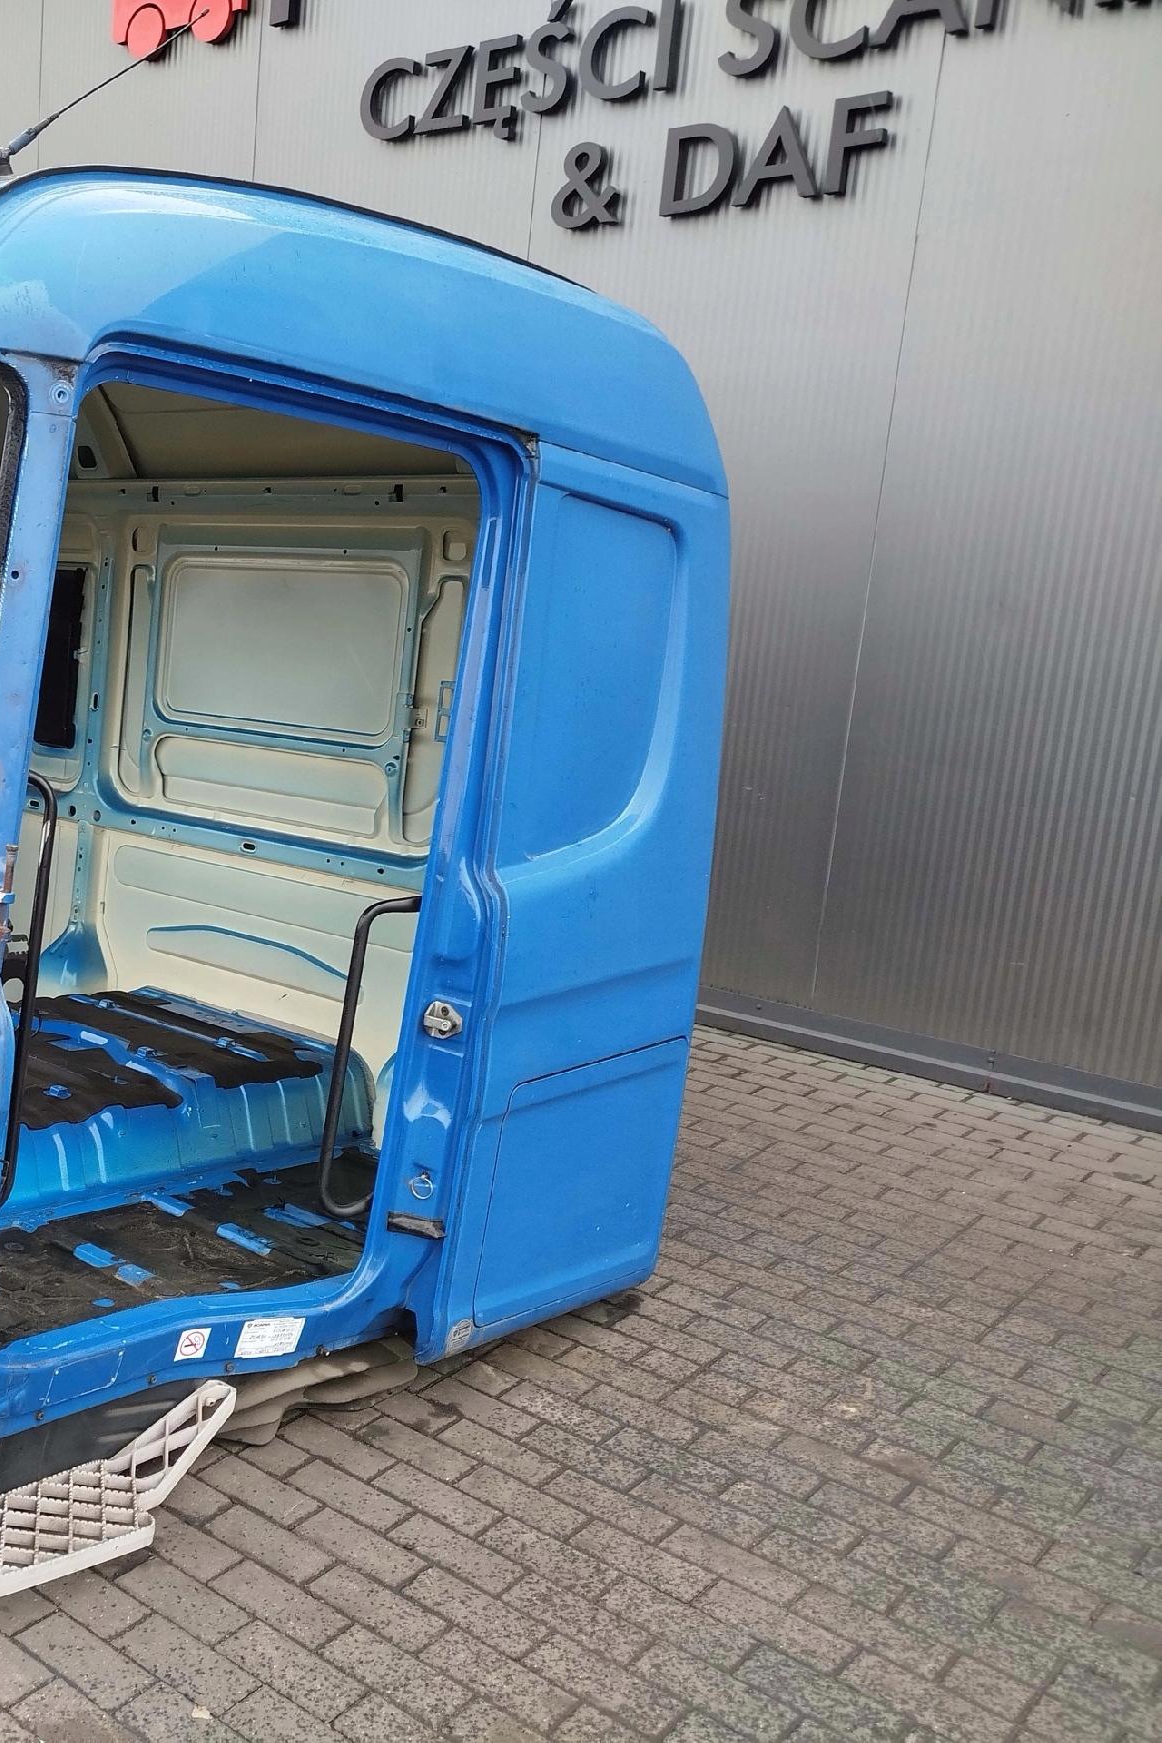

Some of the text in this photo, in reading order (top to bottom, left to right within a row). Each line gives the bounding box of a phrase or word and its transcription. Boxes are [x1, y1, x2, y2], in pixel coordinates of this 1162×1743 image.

[360, 0, 680, 141] CZĘŚCI
[551, 90, 893, 229] & DAF
